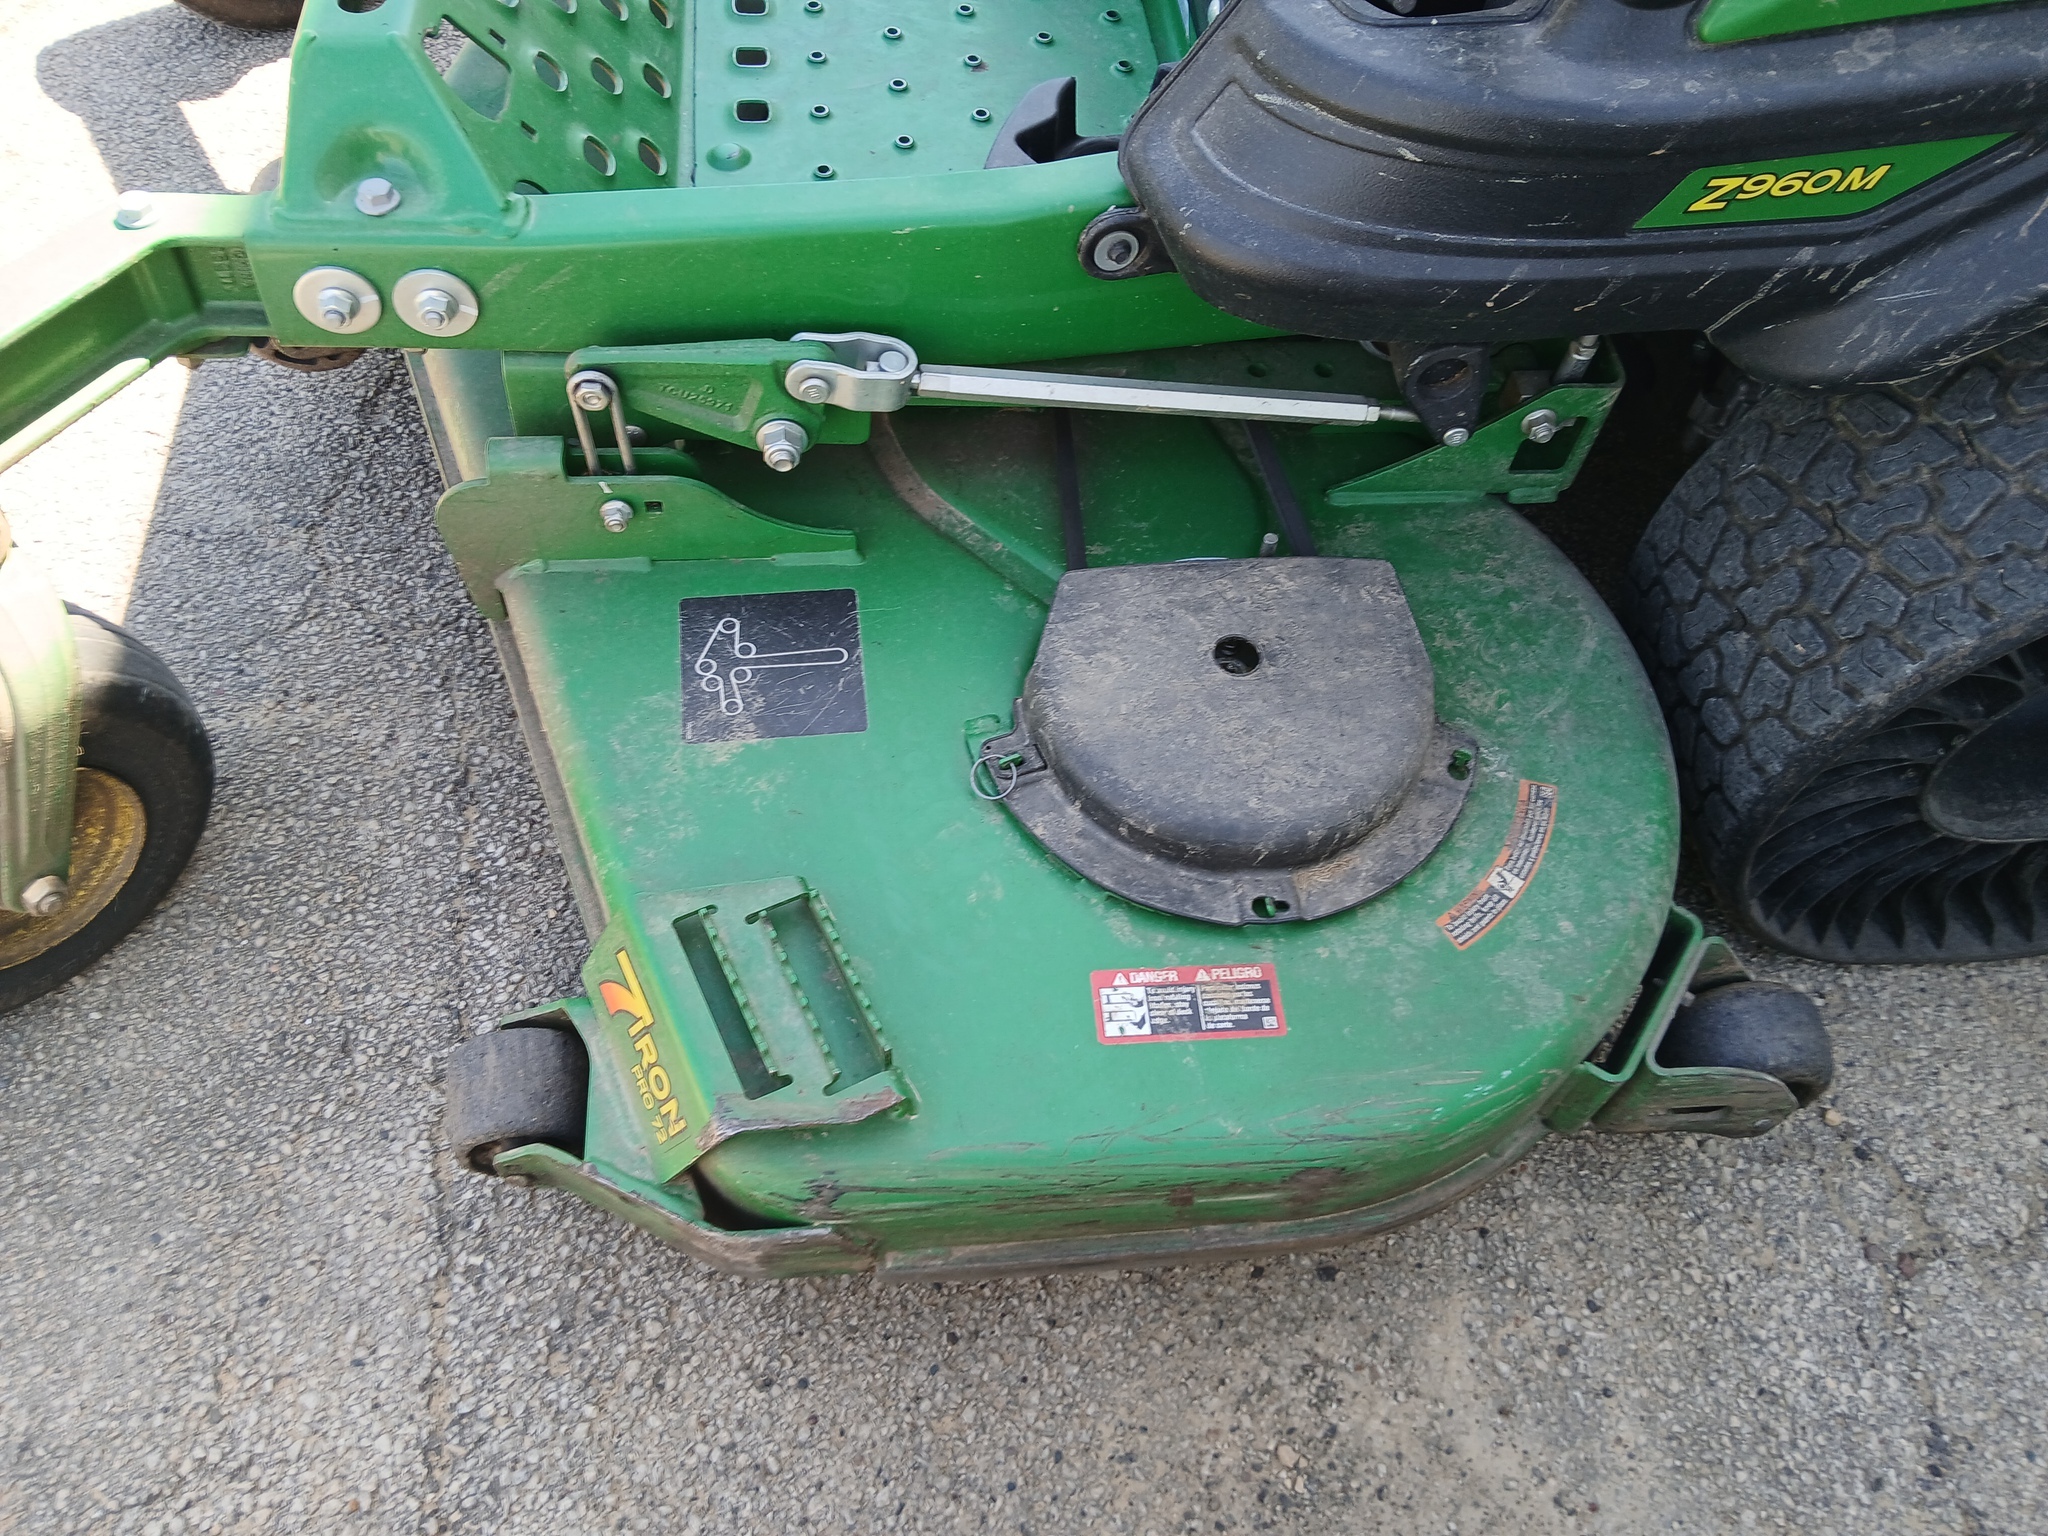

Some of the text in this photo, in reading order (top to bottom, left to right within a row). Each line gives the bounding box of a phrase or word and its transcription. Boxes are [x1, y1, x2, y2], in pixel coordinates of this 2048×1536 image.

[1683, 162, 1894, 214] Z960M
[1128, 970, 1179, 984] DANGER
[1210, 966, 1262, 980] PELIGRO
[630, 1063, 668, 1145] PRO 72
